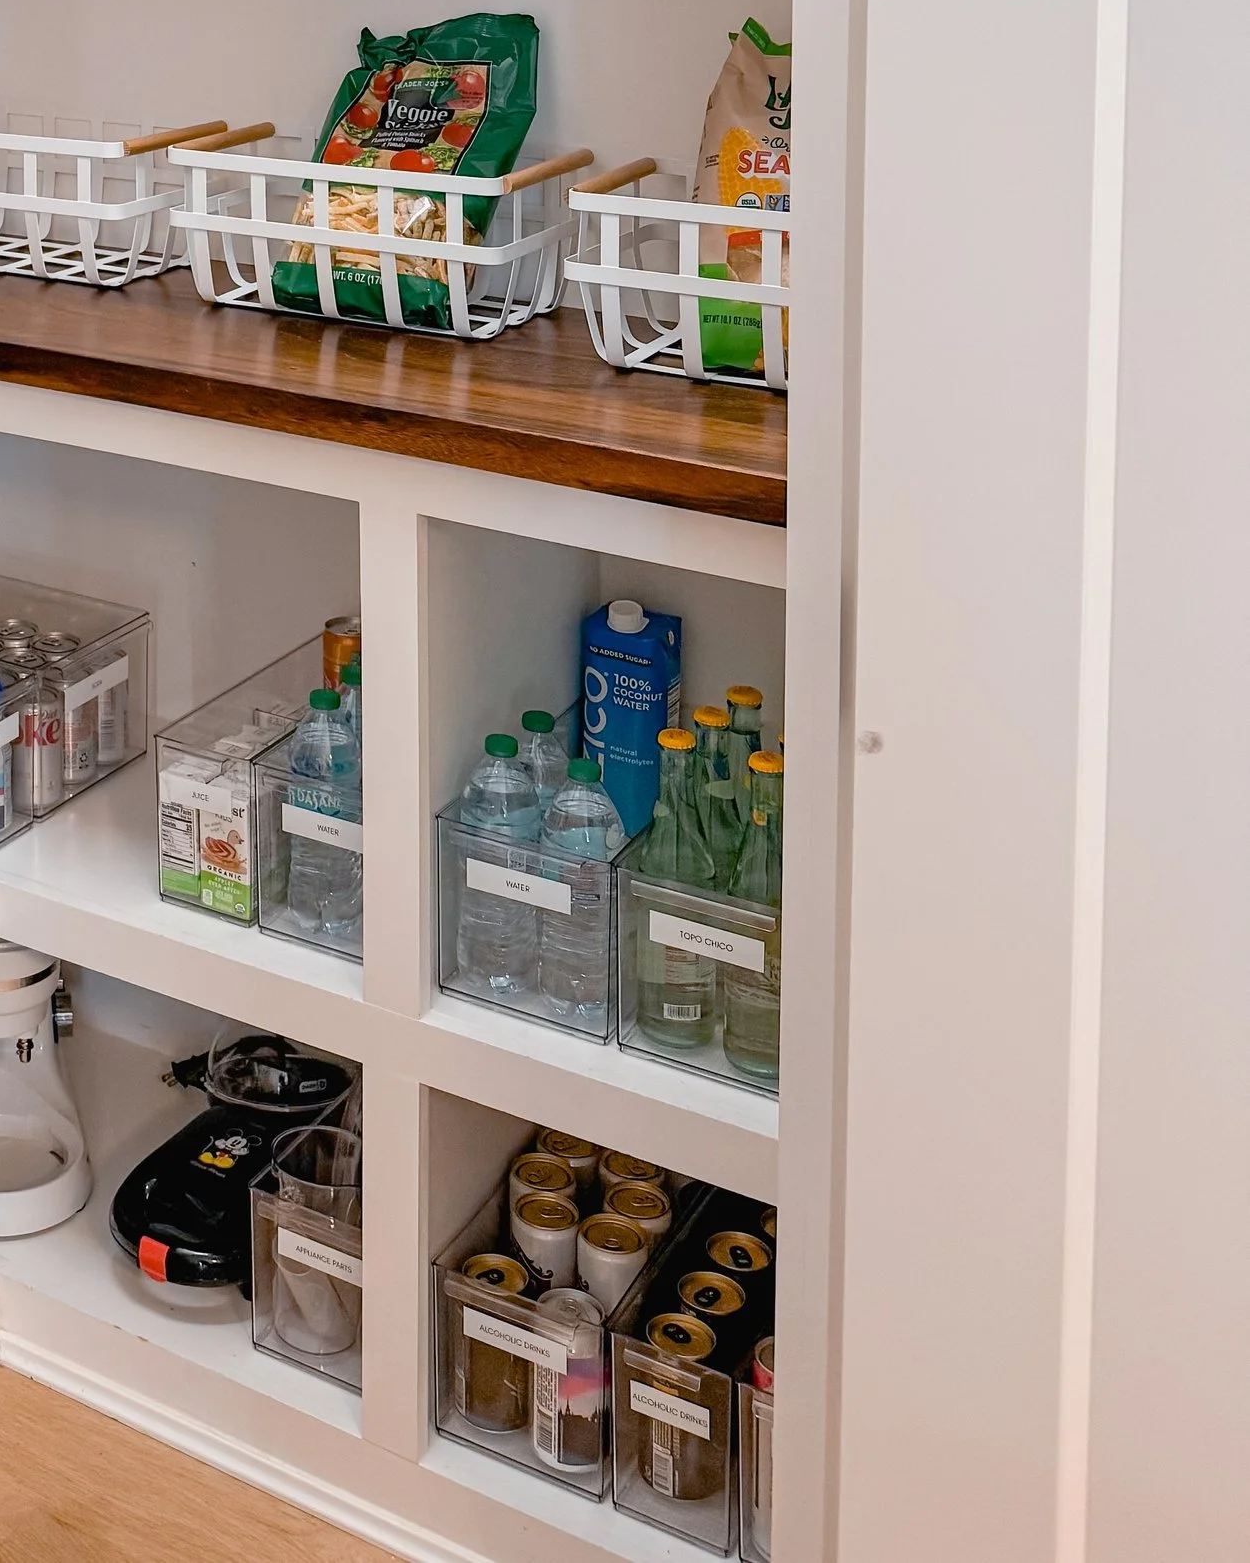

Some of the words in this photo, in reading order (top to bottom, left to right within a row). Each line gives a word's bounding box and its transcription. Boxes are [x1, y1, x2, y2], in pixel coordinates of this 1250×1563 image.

[387, 98, 449, 123] Veggie
[737, 149, 790, 175] SEA
[347, 272, 353, 282] 6
[354, 272, 366, 283] OZ
[599, 648, 624, 659] ADDED
[613, 673, 652, 692] 100%
[613, 686, 663, 702] COCONUT
[613, 696, 650, 711] WATER
[610, 745, 638, 757] natural
[609, 753, 654, 767] electrolytes
[191, 791, 210, 802] JUICE
[317, 824, 340, 836] WATER
[206, 864, 242, 881] ORGANIC
[505, 879, 531, 894] WATER
[679, 929, 703, 944] TOPO
[704, 937, 734, 953] CHICO
[295, 1245, 332, 1266] APPLIANCE
[332, 1259, 353, 1274] PARTS
[479, 1324, 523, 1347] ALCOHOLIC
[523, 1340, 551, 1358] DRINKS
[632, 1392, 679, 1417] ALCOHOLIC
[679, 1408, 709, 1428] DRINKS
